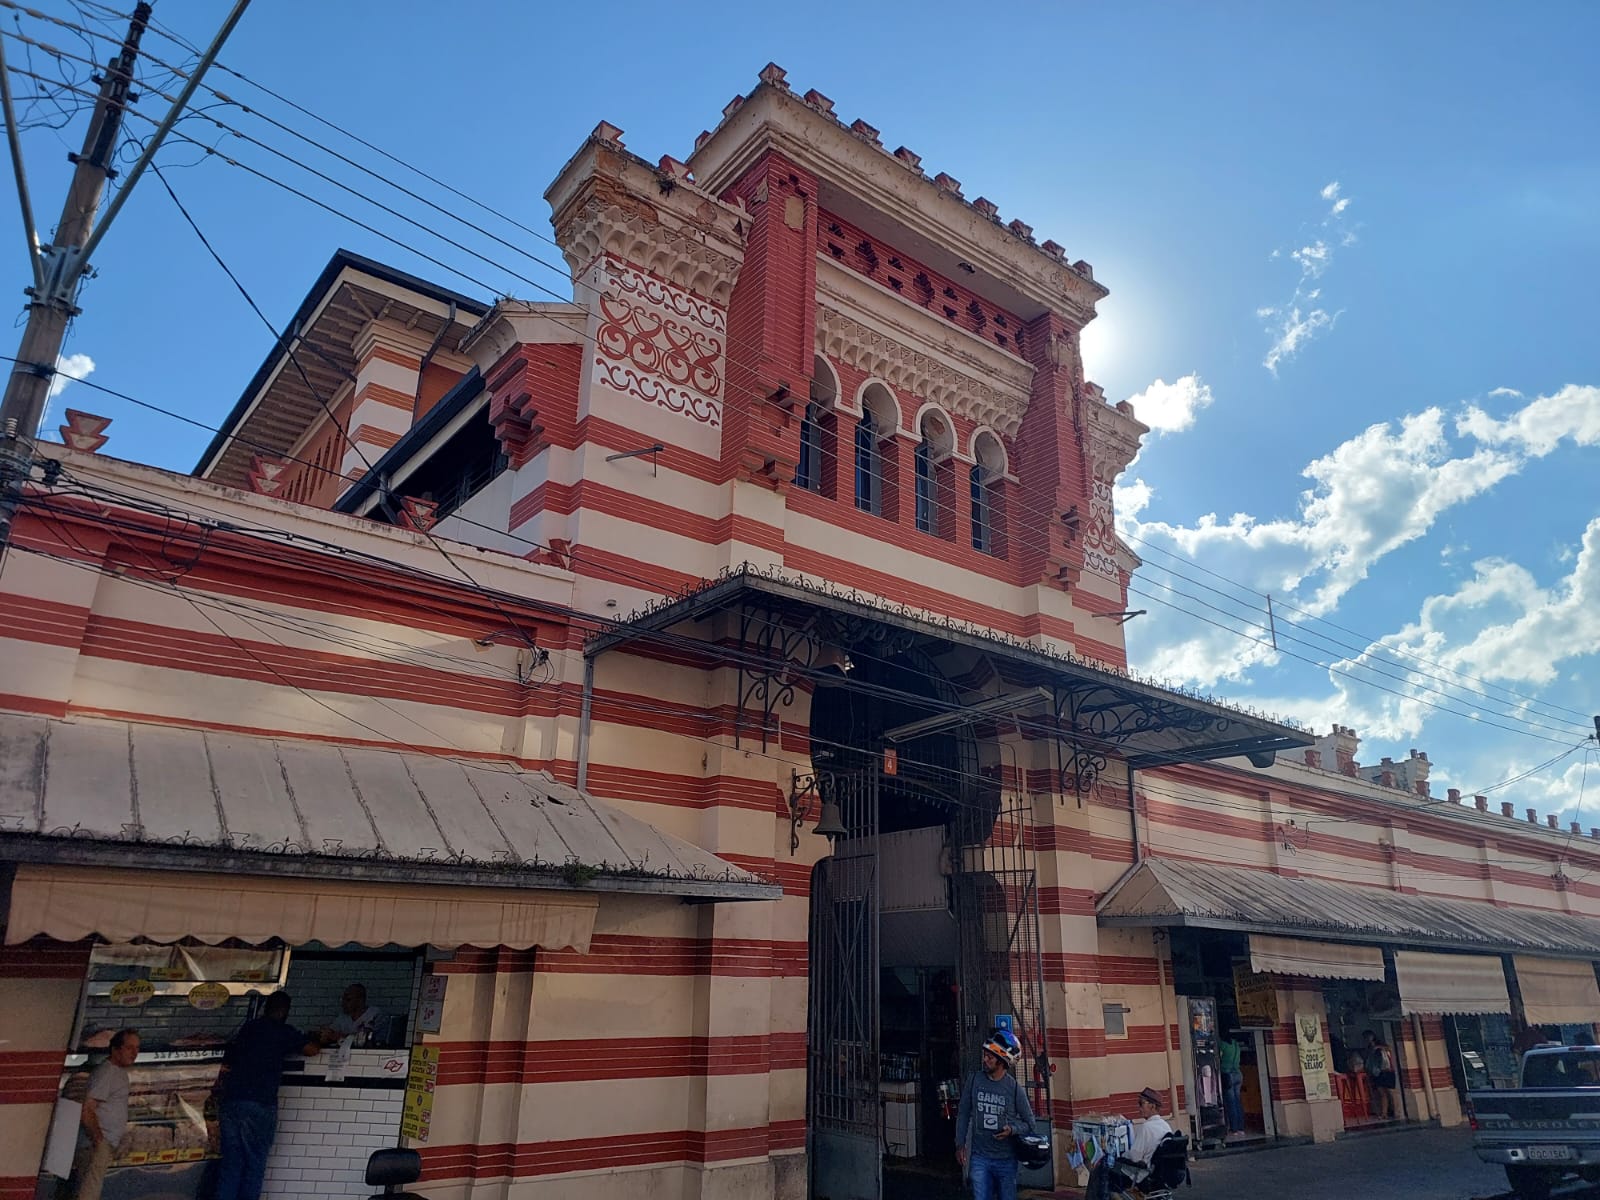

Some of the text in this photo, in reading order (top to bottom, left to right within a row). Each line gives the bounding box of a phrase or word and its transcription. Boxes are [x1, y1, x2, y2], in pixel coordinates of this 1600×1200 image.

[887, 758, 893, 769] 4
[113, 985, 151, 995] BANHA
[1306, 1054, 1319, 1062] COCO
[1304, 1061, 1323, 1069] GELADO
[978, 1092, 1006, 1105] GANG
[1486, 1120, 1600, 1129] CHEVROLET
